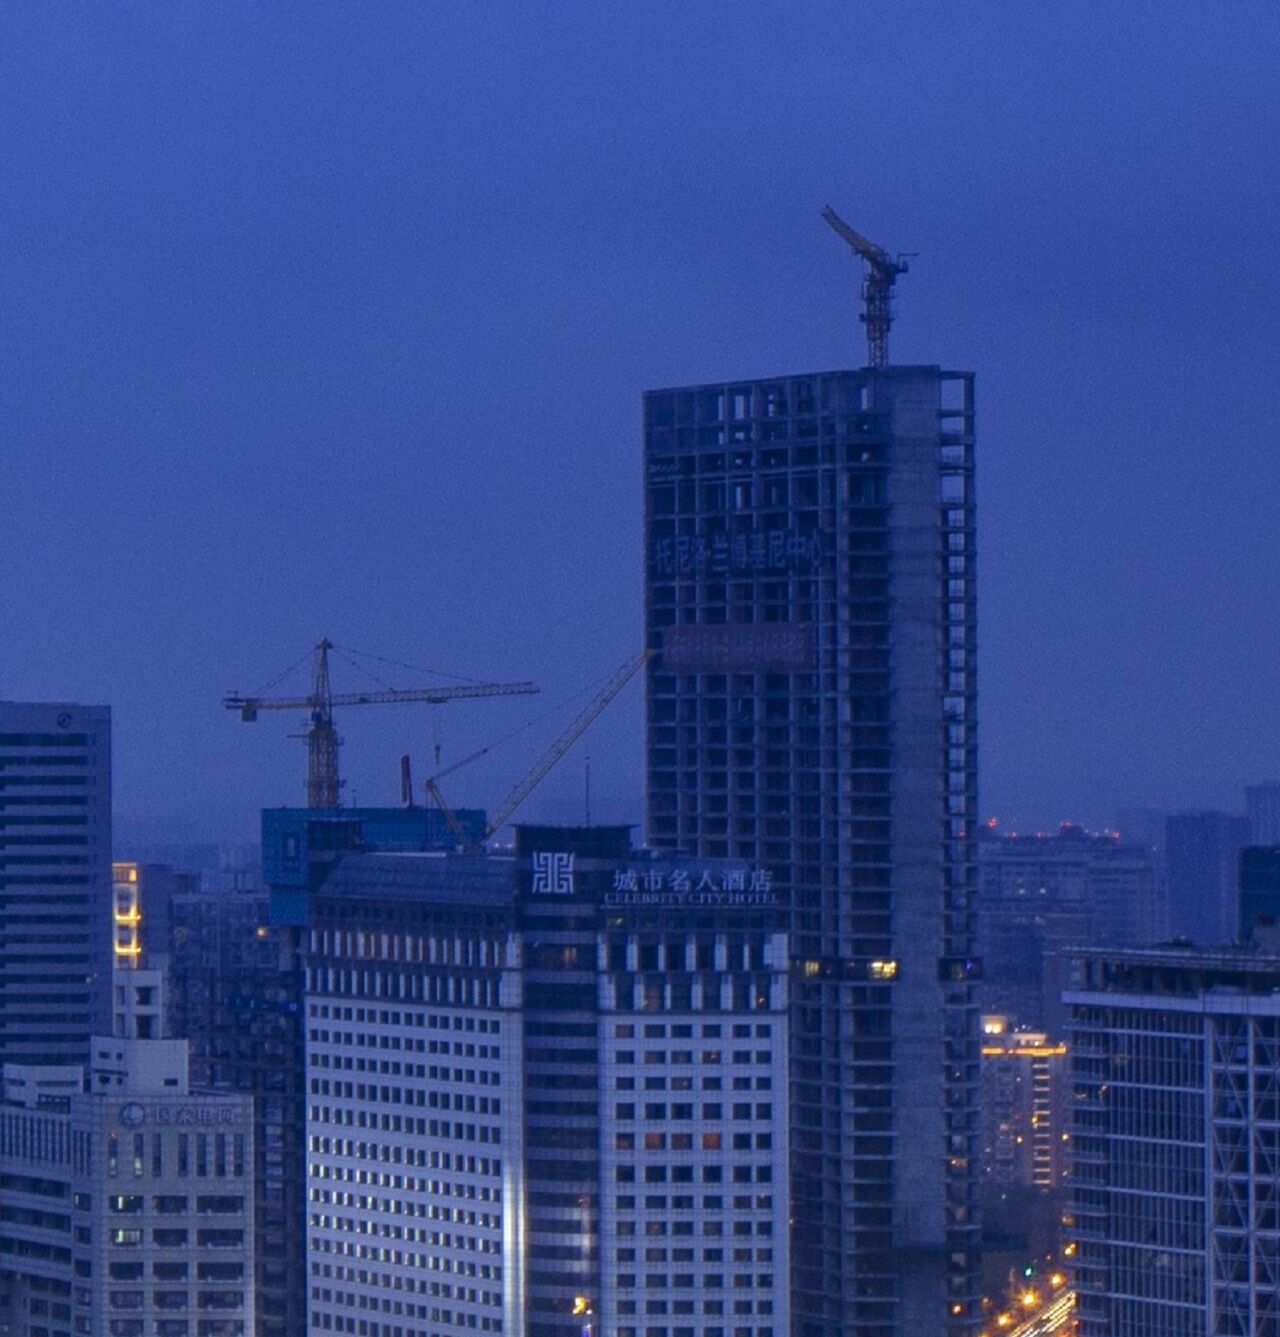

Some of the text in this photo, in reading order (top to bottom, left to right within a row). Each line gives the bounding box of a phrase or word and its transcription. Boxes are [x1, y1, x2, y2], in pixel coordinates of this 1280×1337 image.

[613, 868, 773, 892] 城市名人酒店
[604, 892, 778, 904] CELEBRITY CITY HOTEL
